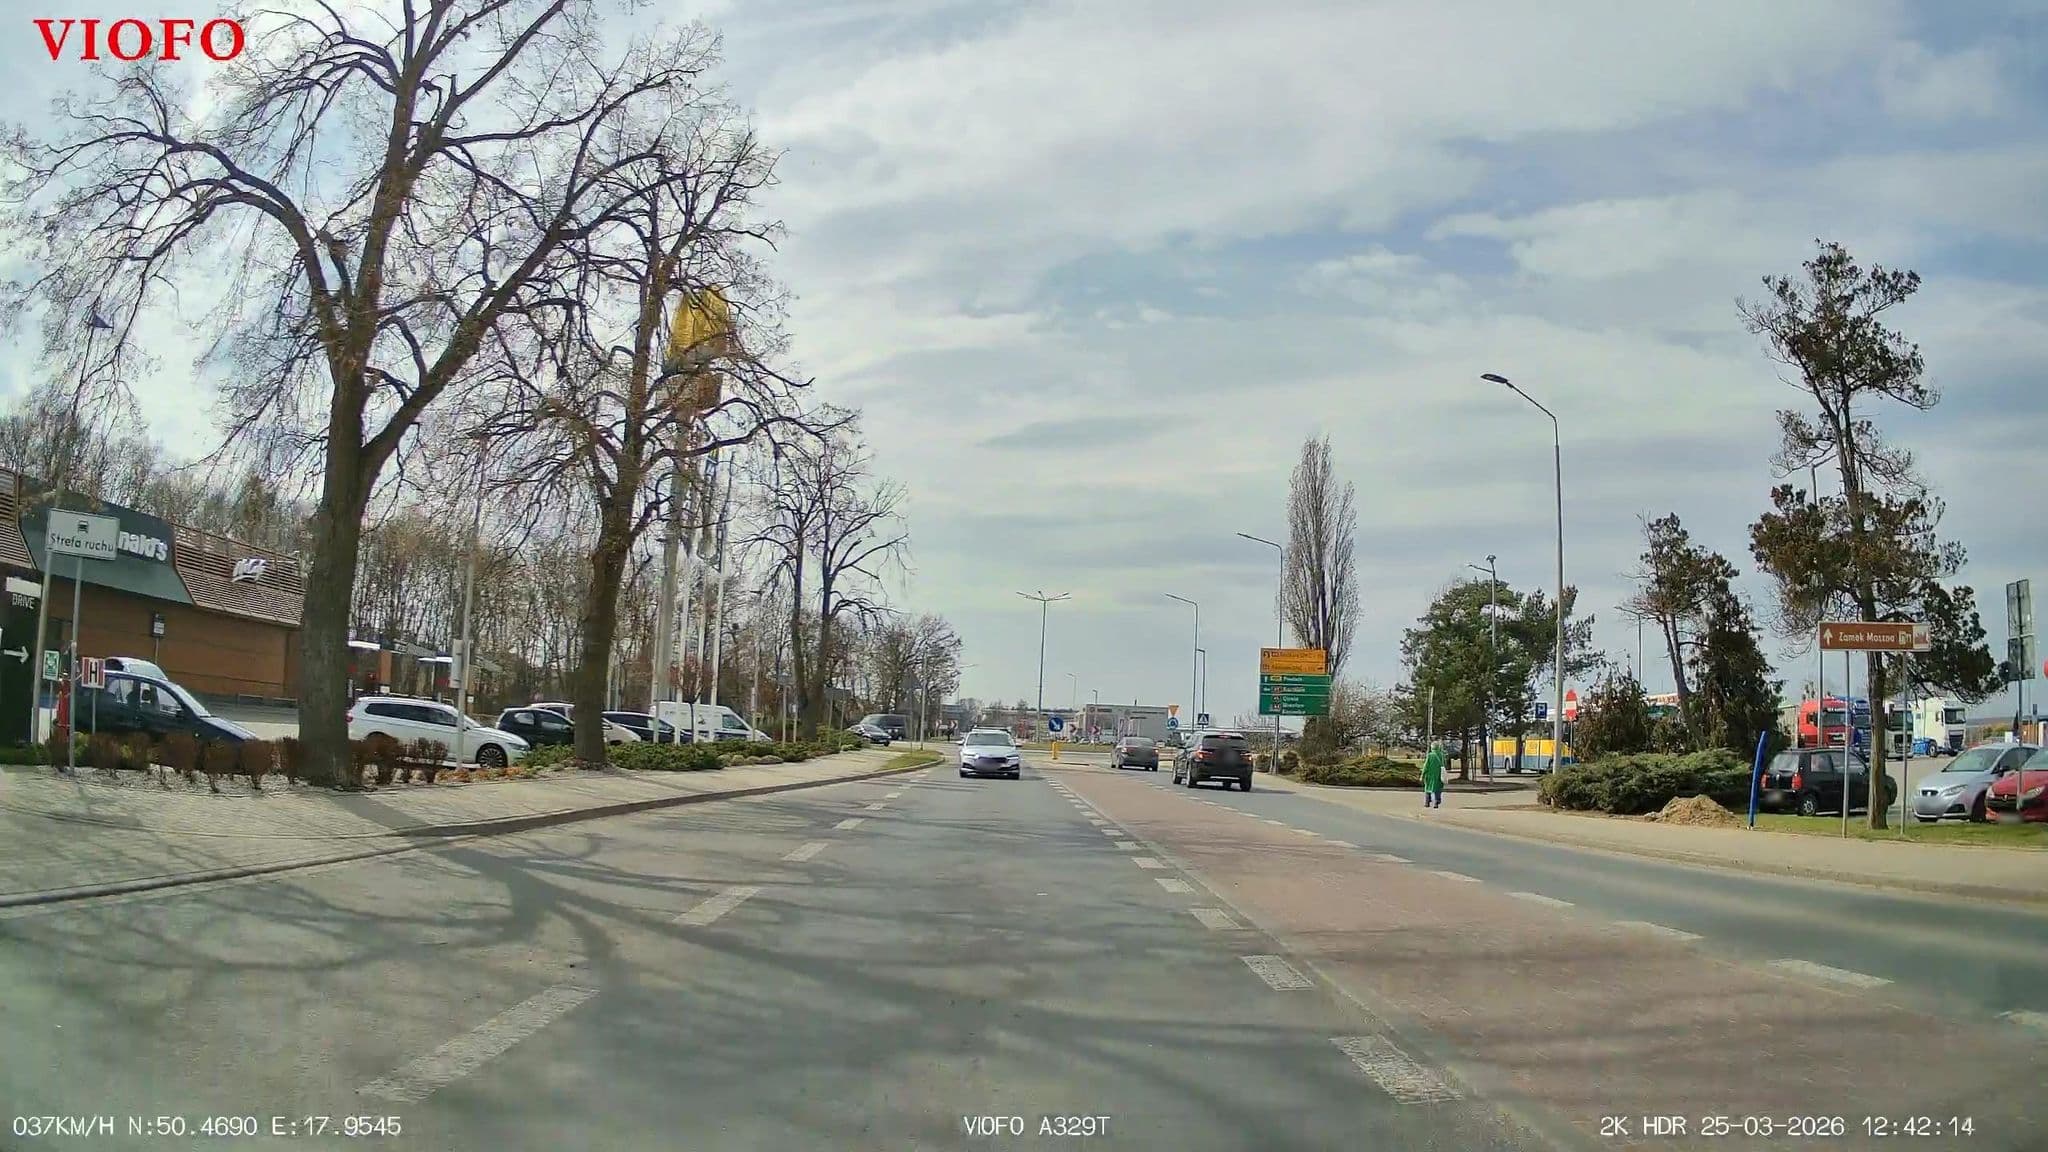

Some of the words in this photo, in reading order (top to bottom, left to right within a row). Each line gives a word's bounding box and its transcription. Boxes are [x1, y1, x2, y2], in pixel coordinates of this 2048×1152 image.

[50, 533, 81, 548] Strefa
[85, 541, 114, 552] ruchu
[12, 593, 35, 610] DRIVE
[1839, 631, 1865, 643] Zamek
[89, 660, 98, 683] H
